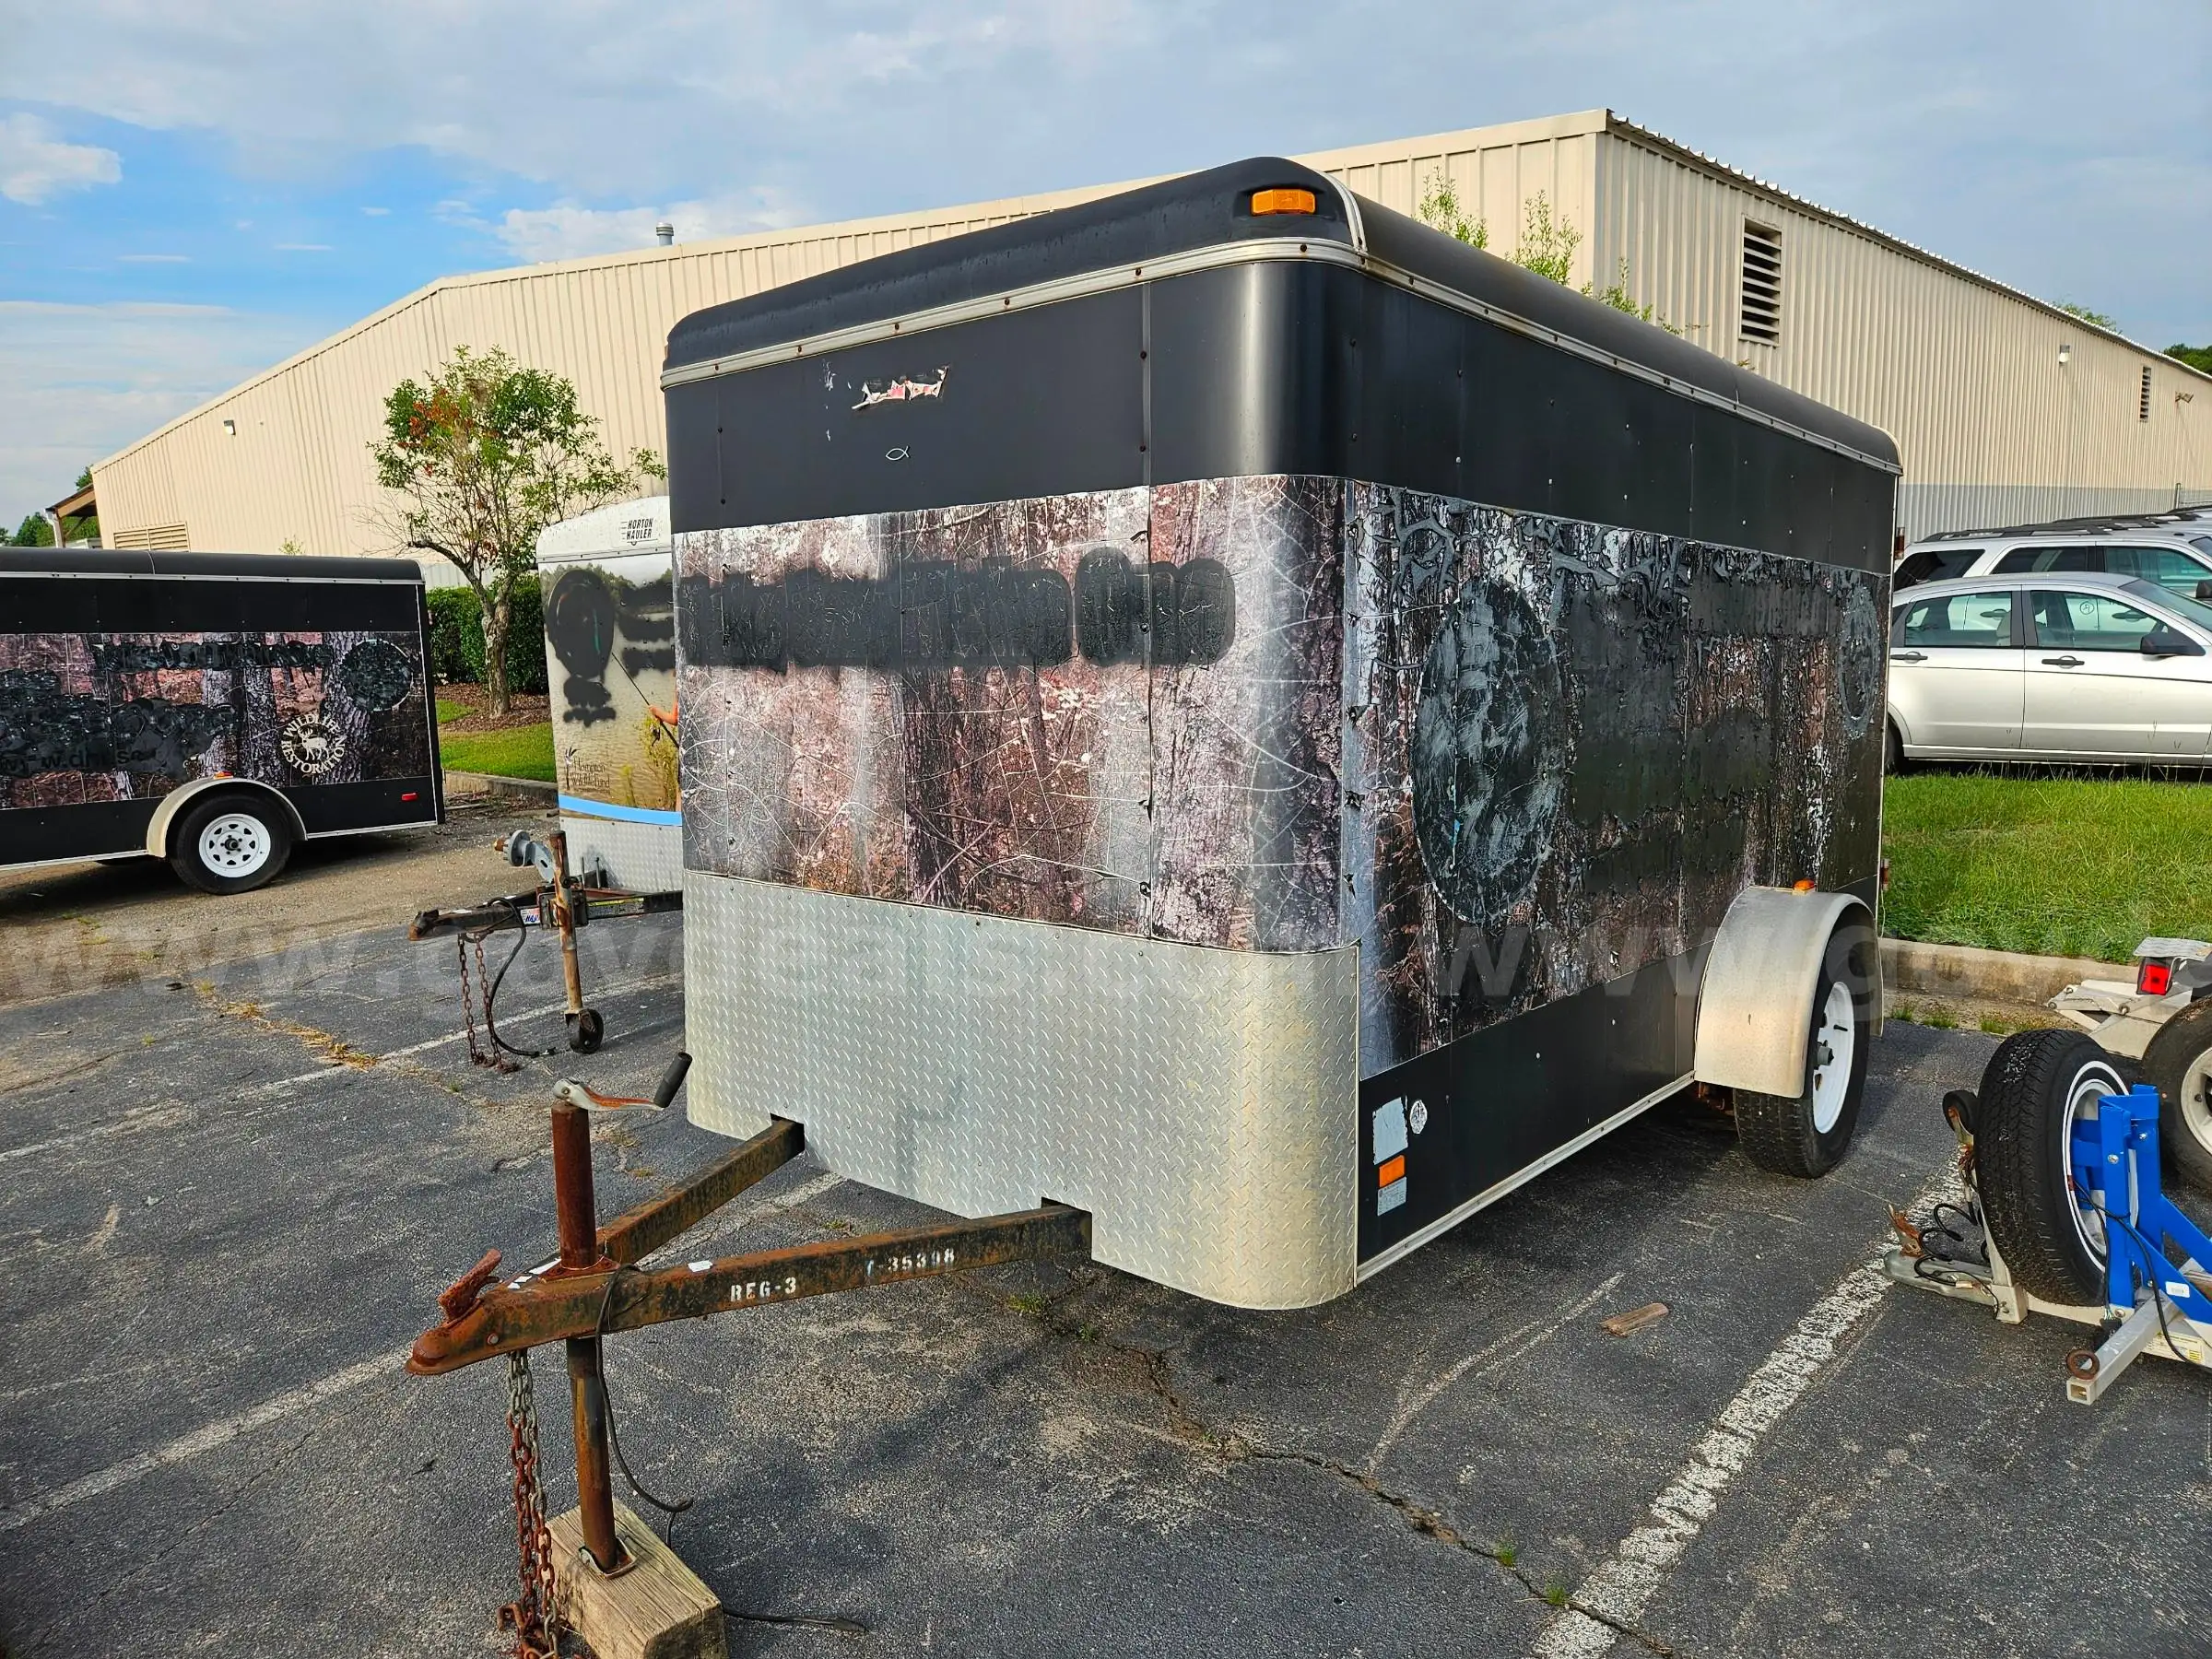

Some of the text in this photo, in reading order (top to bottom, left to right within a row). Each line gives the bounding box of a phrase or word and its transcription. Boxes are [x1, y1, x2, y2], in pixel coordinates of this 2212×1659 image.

[626, 528, 653, 540] HAULER
[628, 518, 653, 529] HORTON
[283, 713, 341, 737] WILDLIFE
[281, 735, 347, 773] RESTORATION
[731, 1277, 796, 1302] REG-3
